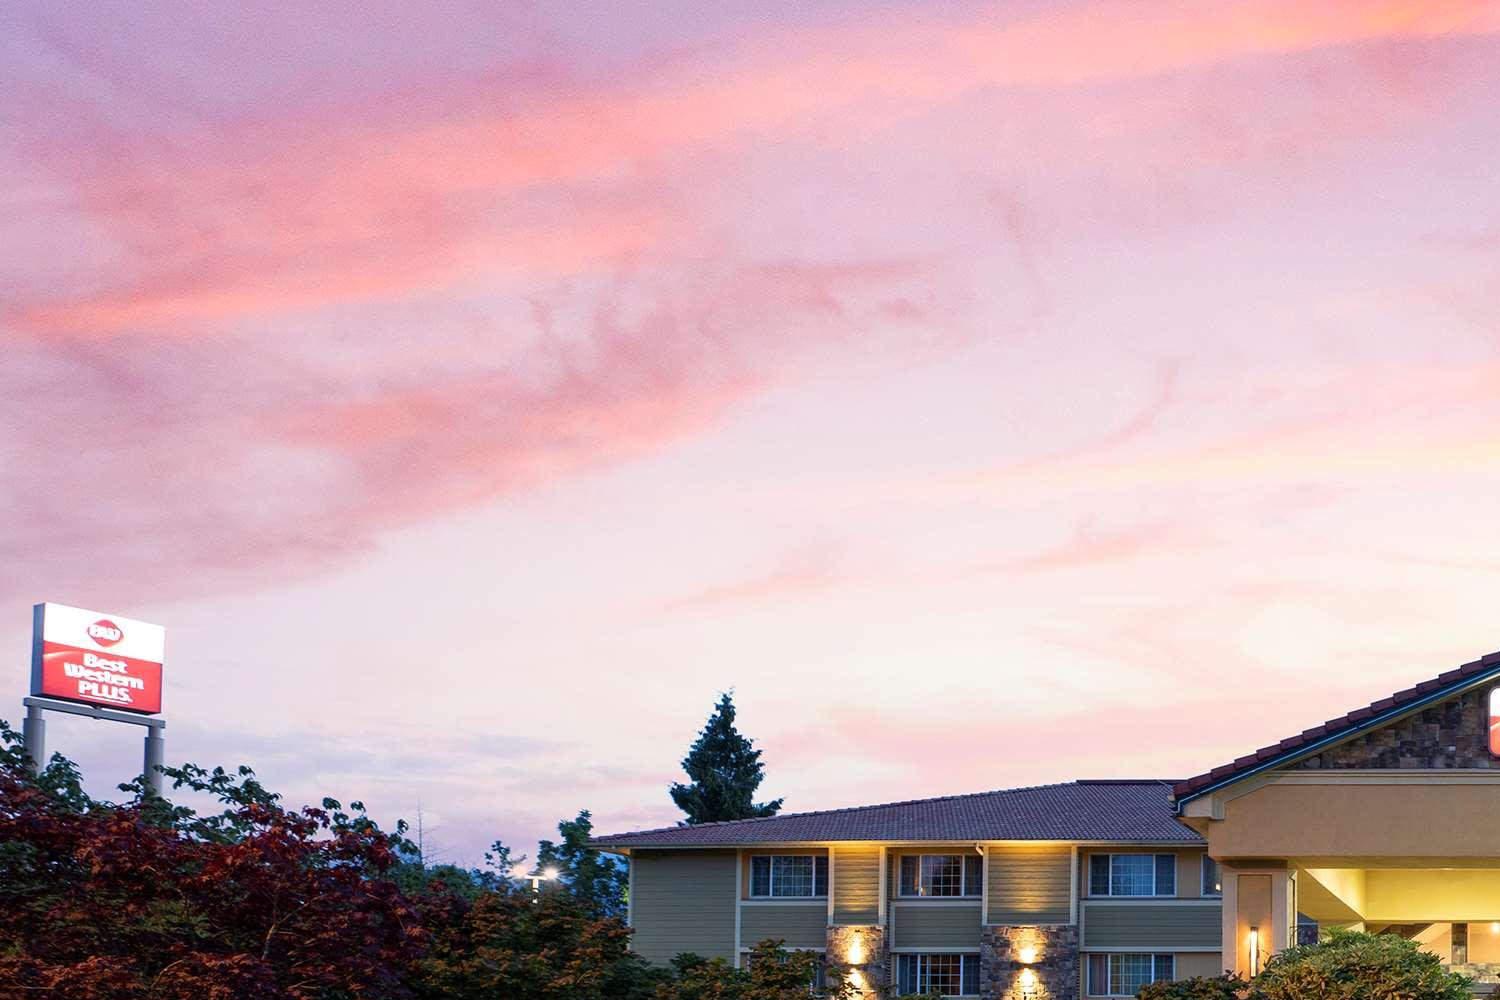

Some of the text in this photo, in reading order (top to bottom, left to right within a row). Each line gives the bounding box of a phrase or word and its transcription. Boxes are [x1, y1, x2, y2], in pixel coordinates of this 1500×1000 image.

[83, 653, 128, 673] Best
[63, 662, 144, 690] Western
[78, 680, 130, 701] PLUS
